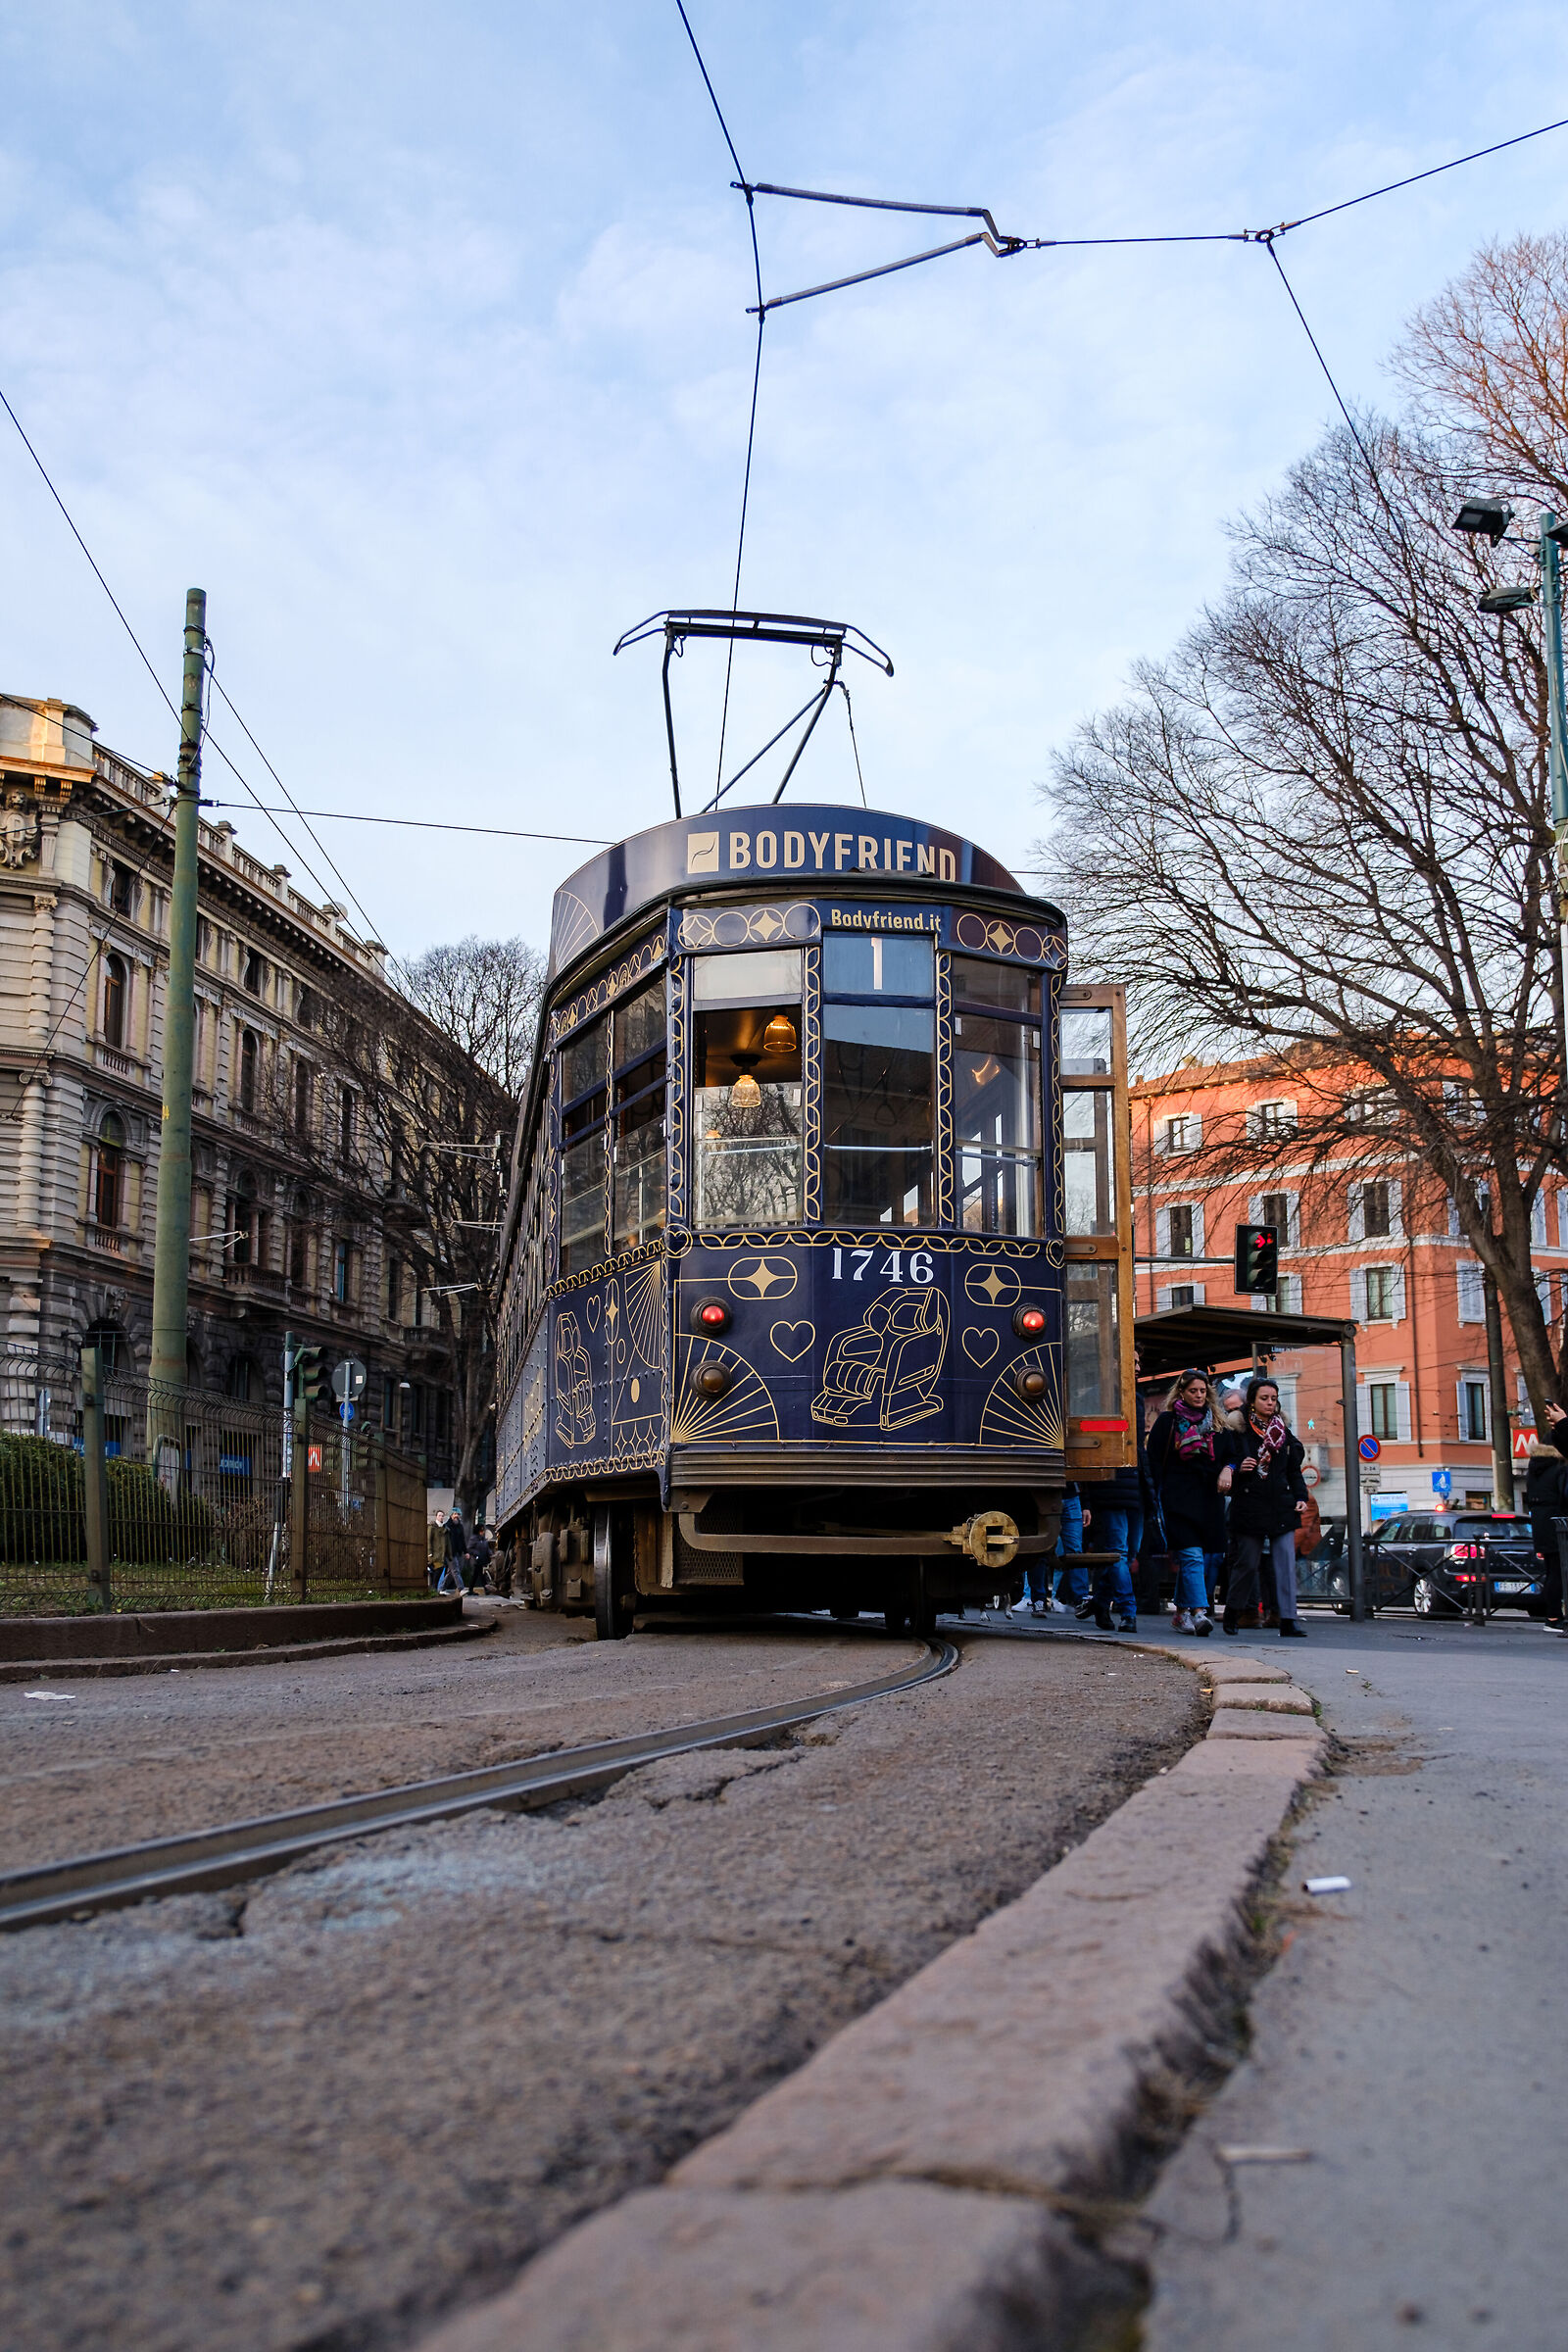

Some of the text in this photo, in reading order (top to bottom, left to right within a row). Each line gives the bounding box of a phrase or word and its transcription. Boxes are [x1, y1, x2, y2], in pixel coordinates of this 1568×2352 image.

[729, 830, 956, 883] BODYFRIEND
[830, 908, 942, 932] Bodyfriend.it
[870, 937, 883, 990] 1
[832, 1248, 934, 1284] 1746
[1514, 1433, 1540, 1455] M
